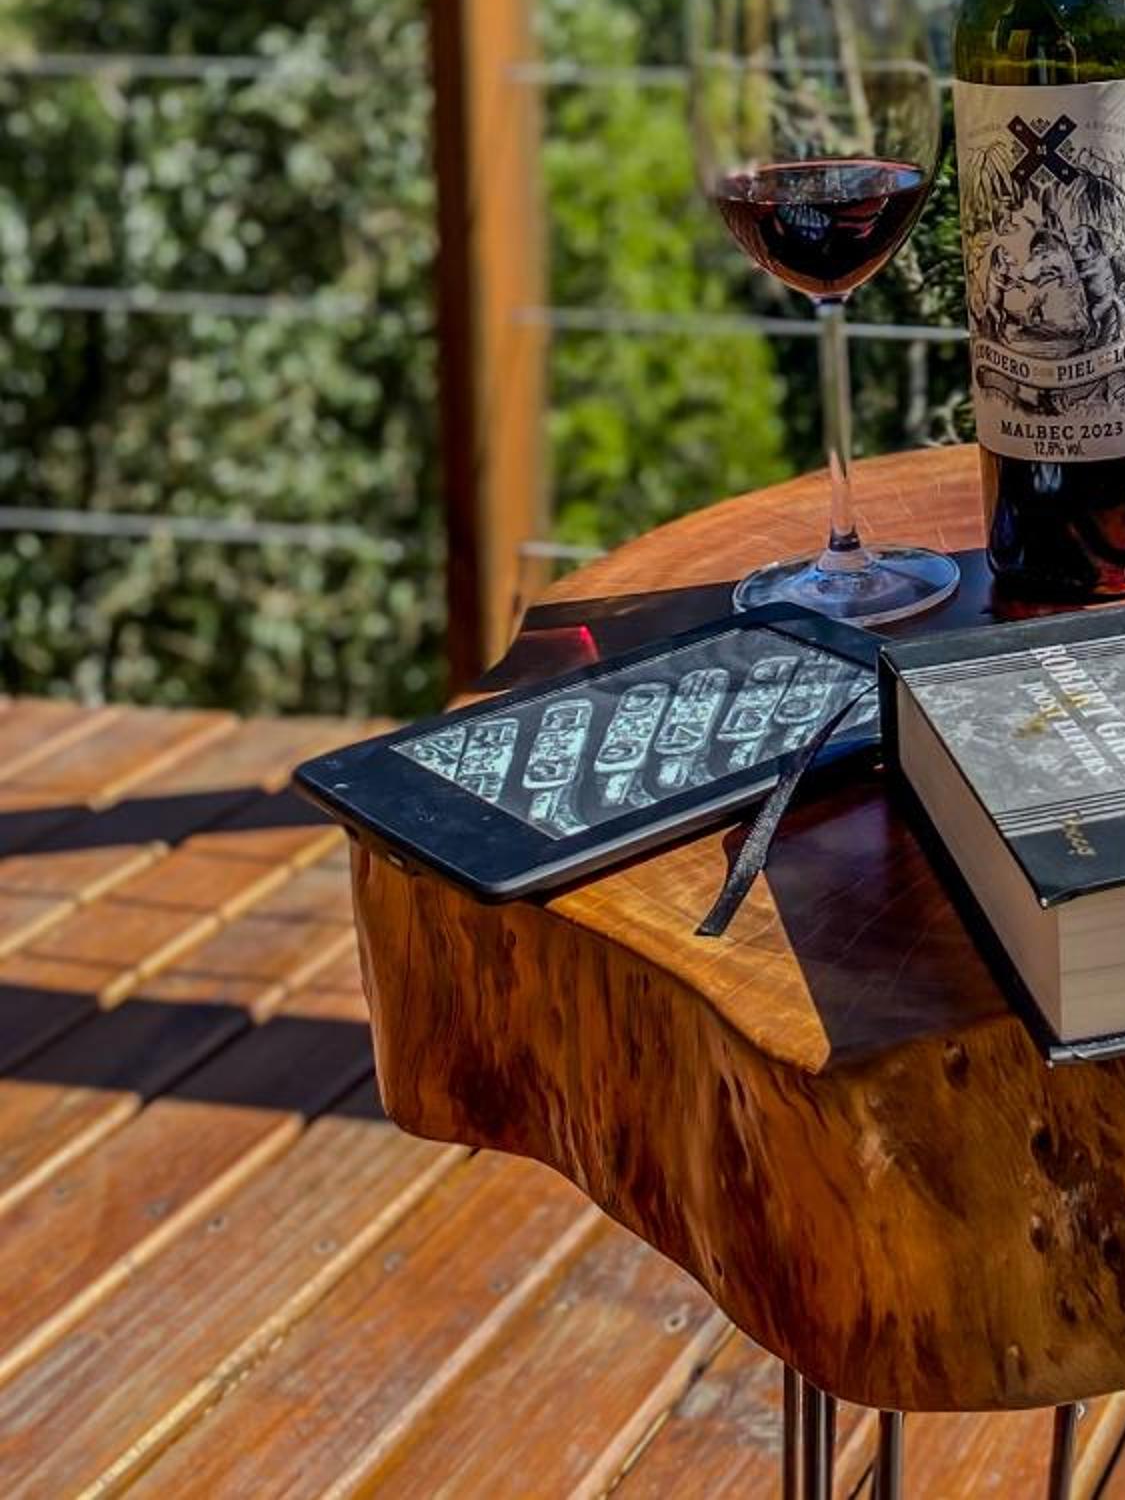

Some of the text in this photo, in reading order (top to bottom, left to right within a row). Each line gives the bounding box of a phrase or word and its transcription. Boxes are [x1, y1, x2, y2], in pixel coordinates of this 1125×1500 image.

[1057, 361, 1095, 381] PIEL
[1001, 420, 1123, 440] MALBEC 2023
[1030, 644, 1122, 718] ROBERT
[1018, 681, 1108, 775] JOOST ELFFERS
